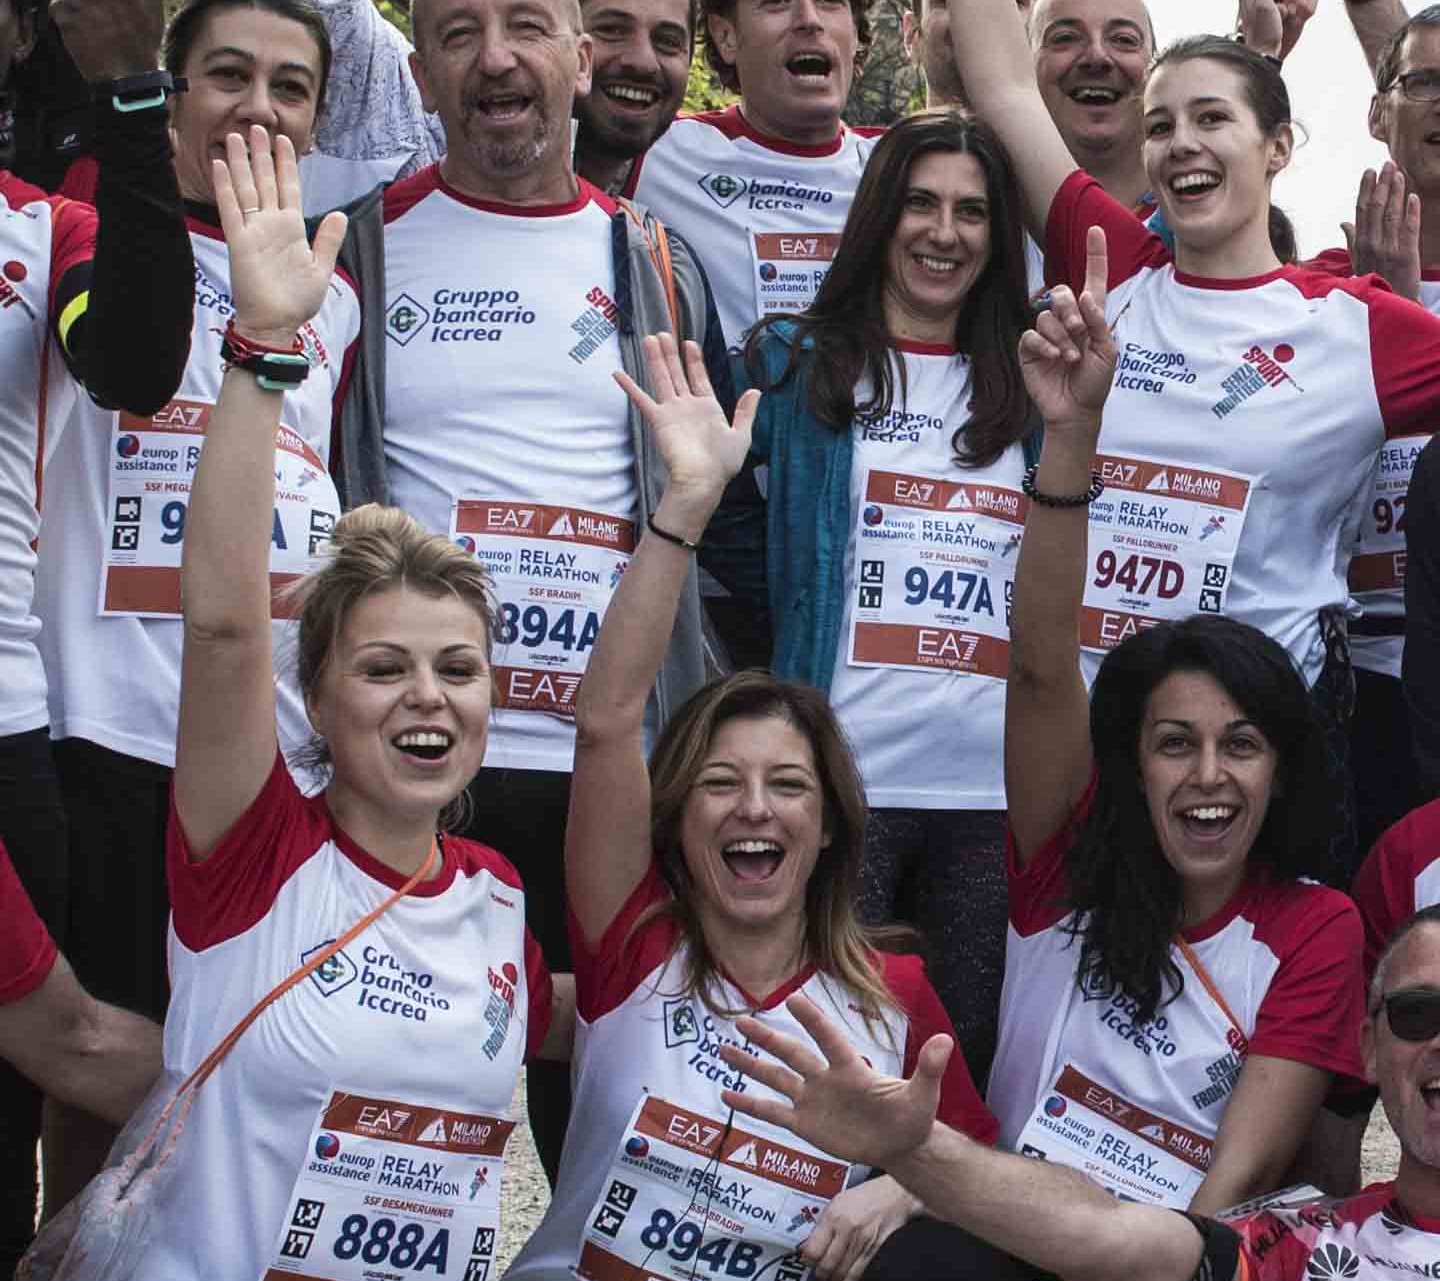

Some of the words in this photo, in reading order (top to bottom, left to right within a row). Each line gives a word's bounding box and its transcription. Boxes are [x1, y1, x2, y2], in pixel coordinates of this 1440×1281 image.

[749, 180, 833, 203] bancario
[780, 239, 818, 254] EA7
[779, 273, 808, 281] europ
[434, 289, 519, 308] Gruppo
[761, 284, 808, 292] assistance
[432, 306, 536, 324] bancario
[432, 326, 502, 342] Iccrea
[1120, 355, 1196, 384] bancario
[1243, 345, 1290, 388] SPORT
[1221, 363, 1257, 393] SENZA
[142, 446, 178, 461] europ
[115, 459, 177, 471] assistance
[1101, 462, 1137, 481] EA7
[895, 480, 935, 499] EA7
[1173, 473, 1221, 490] MILANO
[975, 490, 1019, 510] MILANO
[1120, 501, 1168, 519] RELAY
[488, 508, 535, 528] EA7
[883, 519, 915, 530] europ
[923, 520, 976, 534] RELAY
[1118, 515, 1188, 535] MARATHON
[862, 529, 915, 540] assistance
[923, 532, 996, 551] MARATHON
[477, 550, 512, 562] europ
[520, 550, 576, 566] RELAY
[519, 565, 600, 584] MARATHON
[1094, 550, 1184, 599] 947D
[904, 566, 994, 616] 947A
[918, 629, 981, 661] EA7
[360, 966, 450, 1010] bancario
[359, 989, 427, 1022] Iccrea
[1085, 1087, 1130, 1118] EA7
[358, 1106, 412, 1131] EA7
[1063, 1117, 1096, 1139] europ
[451, 1121, 491, 1138] MILANO
[667, 1114, 721, 1147] EA7
[1036, 1116, 1090, 1150] assistance
[339, 1150, 375, 1169] europ
[1101, 1133, 1159, 1170] RELAY
[309, 1161, 370, 1182] assistance
[383, 1155, 444, 1179] RELAY
[620, 1155, 680, 1183] assistance
[647, 1153, 684, 1174] europ
[763, 1149, 821, 1178] MILANO
[1095, 1146, 1179, 1193] MARATHON
[377, 1172, 459, 1197] MARATHON
[690, 1168, 753, 1199] RELAY
[363, 1195, 381, 1205] SSF
[382, 1198, 454, 1218] BESAMERUNNER
[685, 1179, 776, 1223] MARATHON
[333, 1214, 451, 1274] 888A
[640, 1208, 763, 1278] 894B
